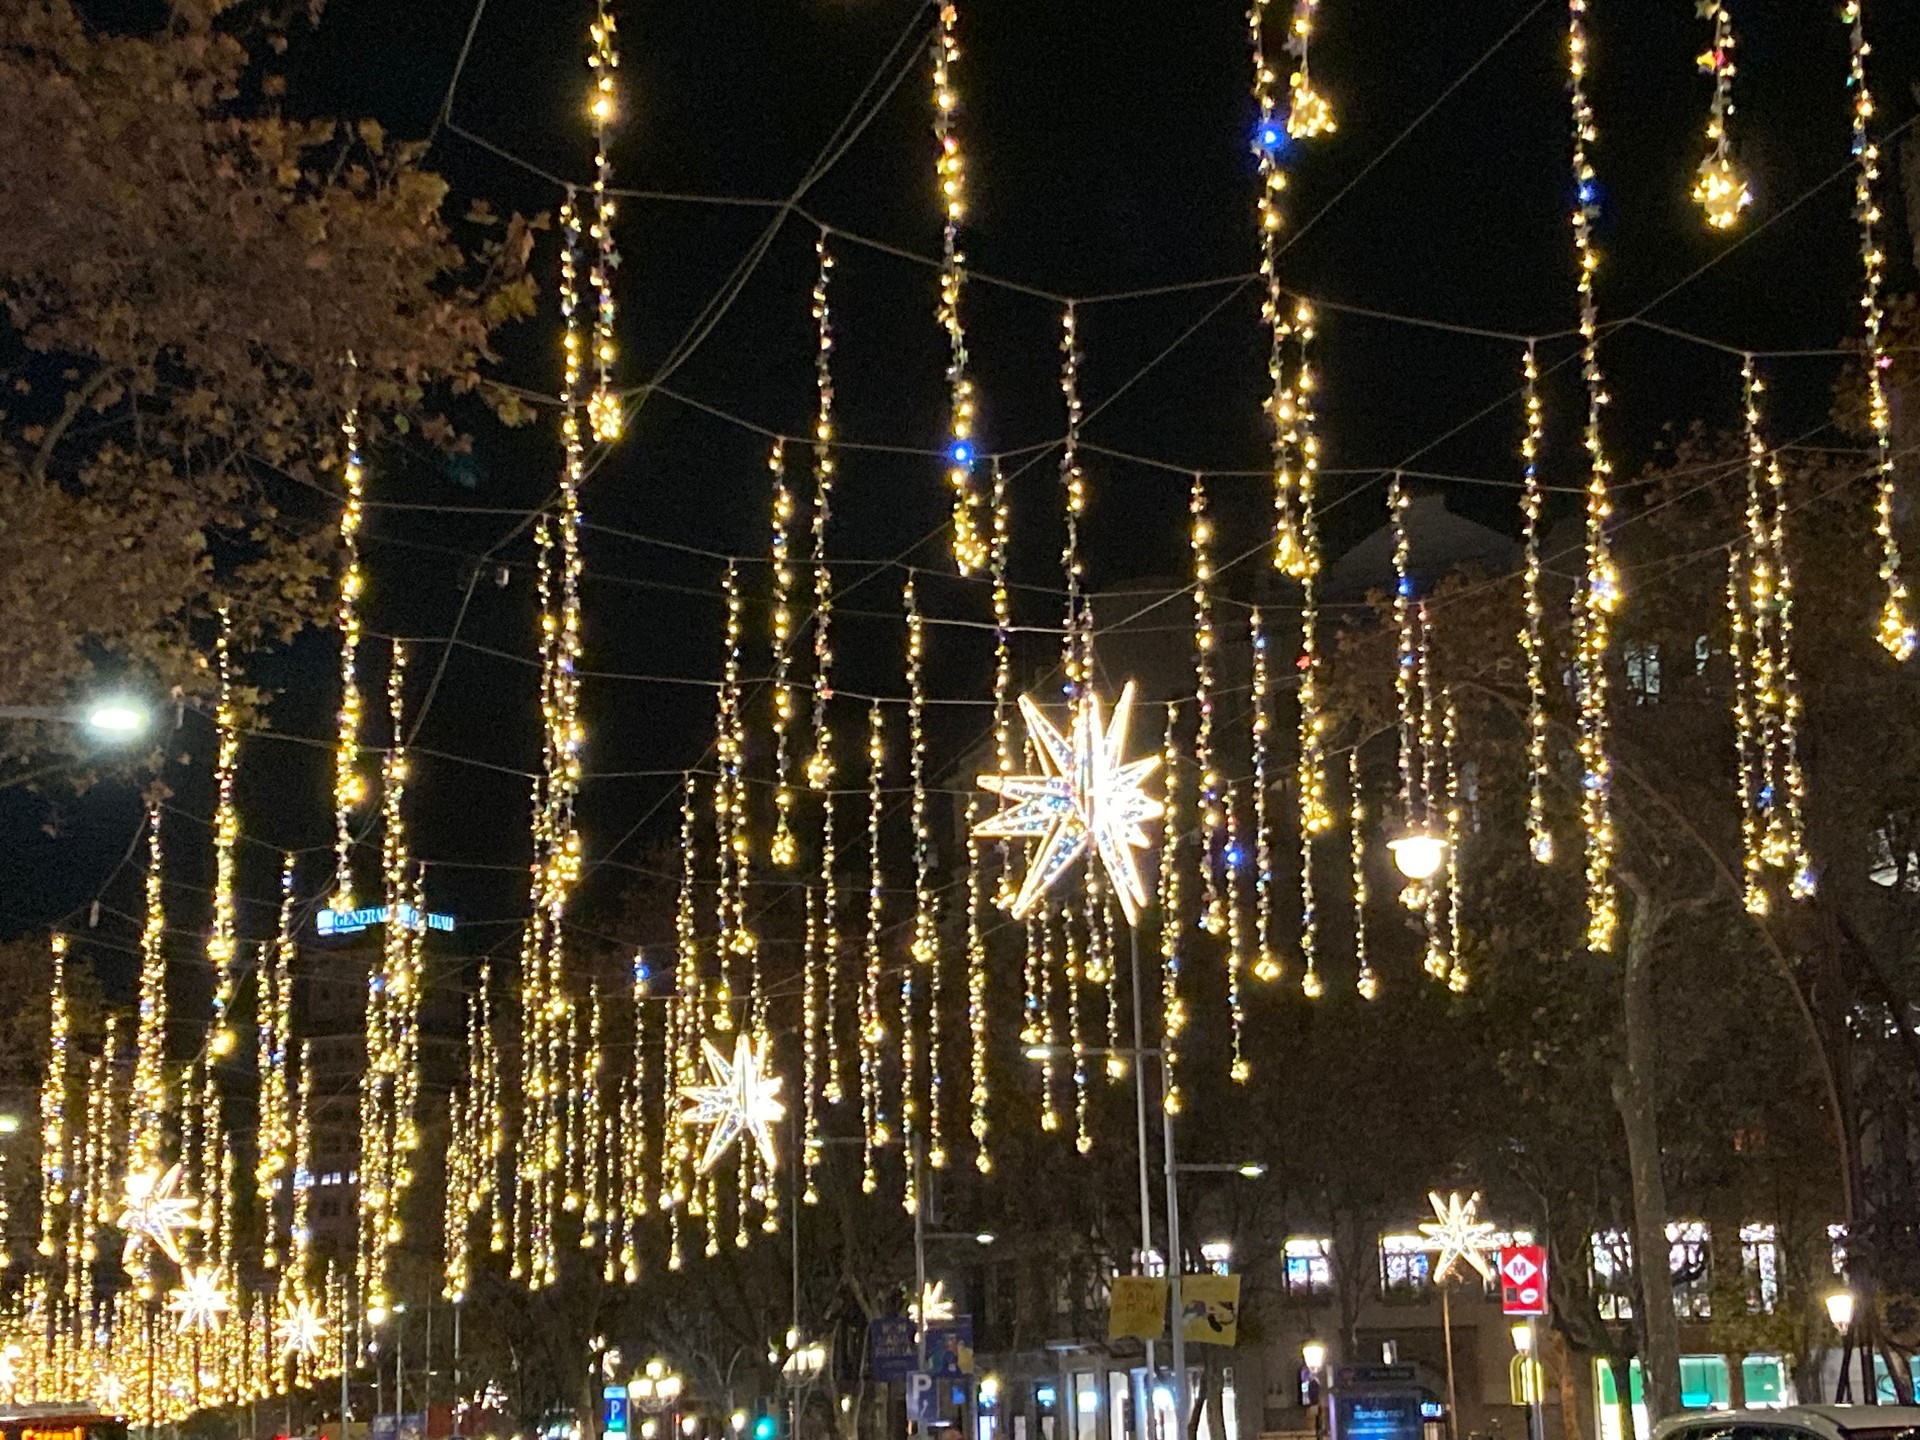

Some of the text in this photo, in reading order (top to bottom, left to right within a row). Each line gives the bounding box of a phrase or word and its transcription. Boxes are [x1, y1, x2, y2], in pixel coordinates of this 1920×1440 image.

[1513, 1262, 1527, 1276] M
[912, 1374, 932, 1400] P
[610, 1400, 621, 1420] P
